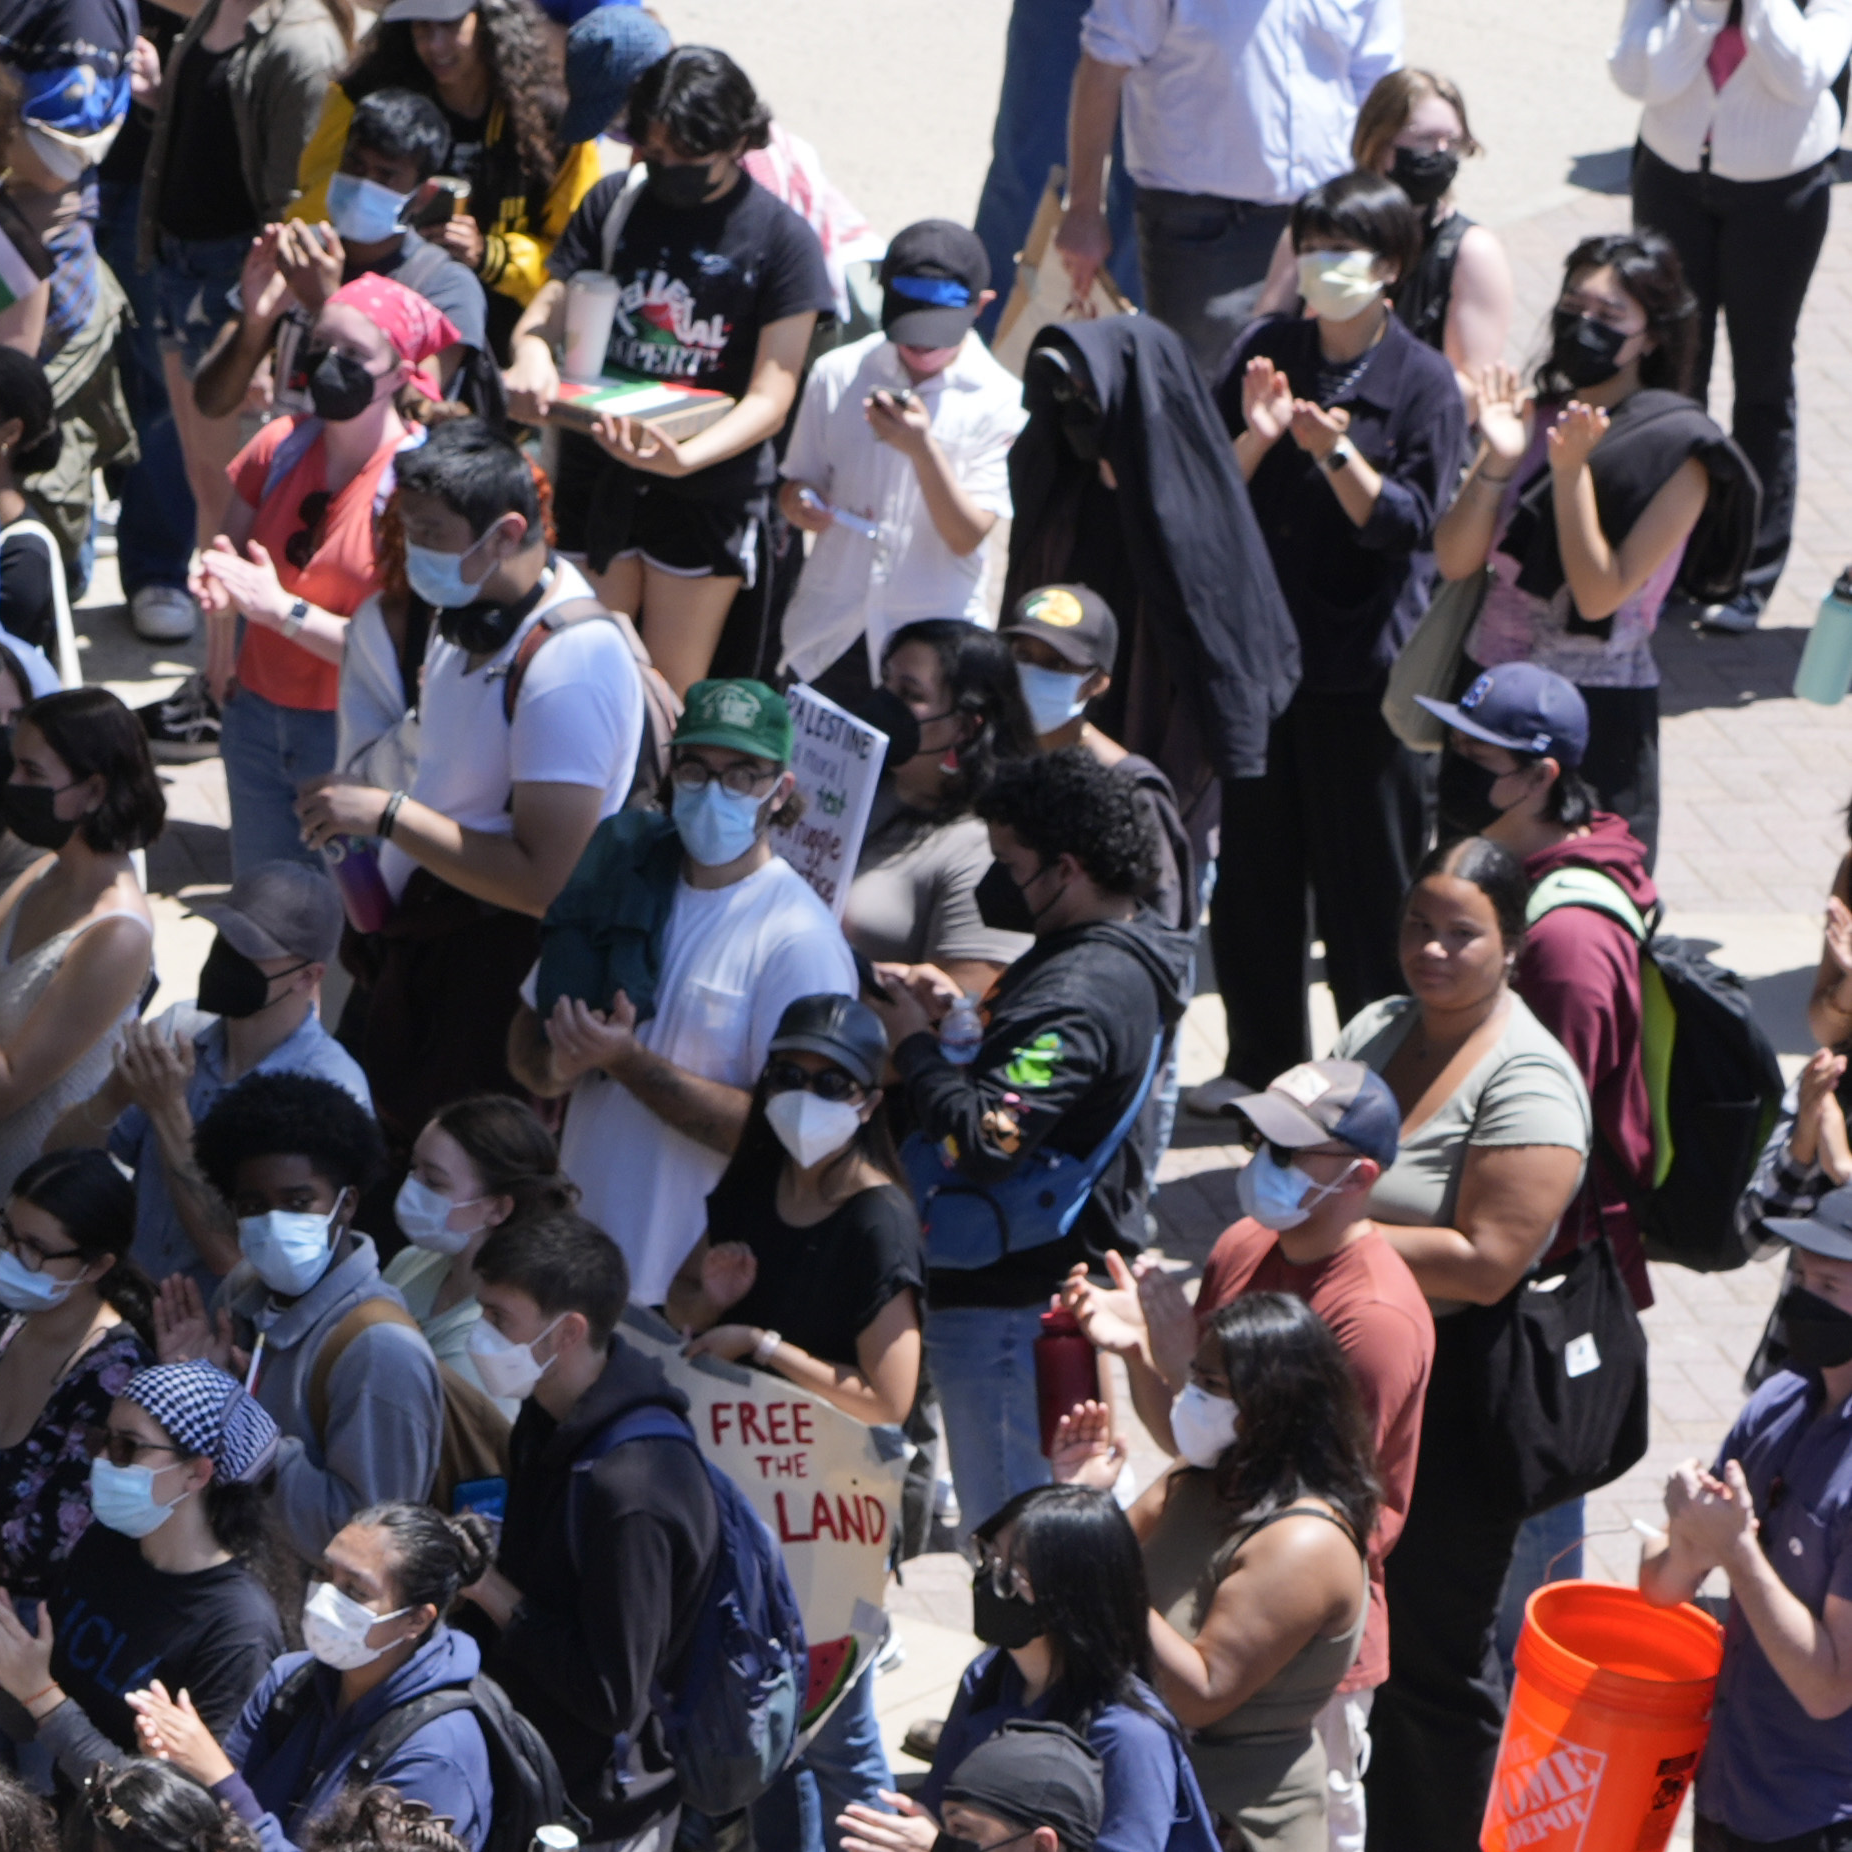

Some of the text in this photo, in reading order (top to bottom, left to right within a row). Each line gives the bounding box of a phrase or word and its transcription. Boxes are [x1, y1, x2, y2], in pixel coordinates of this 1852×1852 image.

[710, 1402, 814, 1445] FREE
[755, 1454, 808, 1481] THE
[774, 1492, 887, 1549] LAND
[1501, 1749, 1601, 1818] OME
[1506, 1797, 1589, 1851] DEPOT
